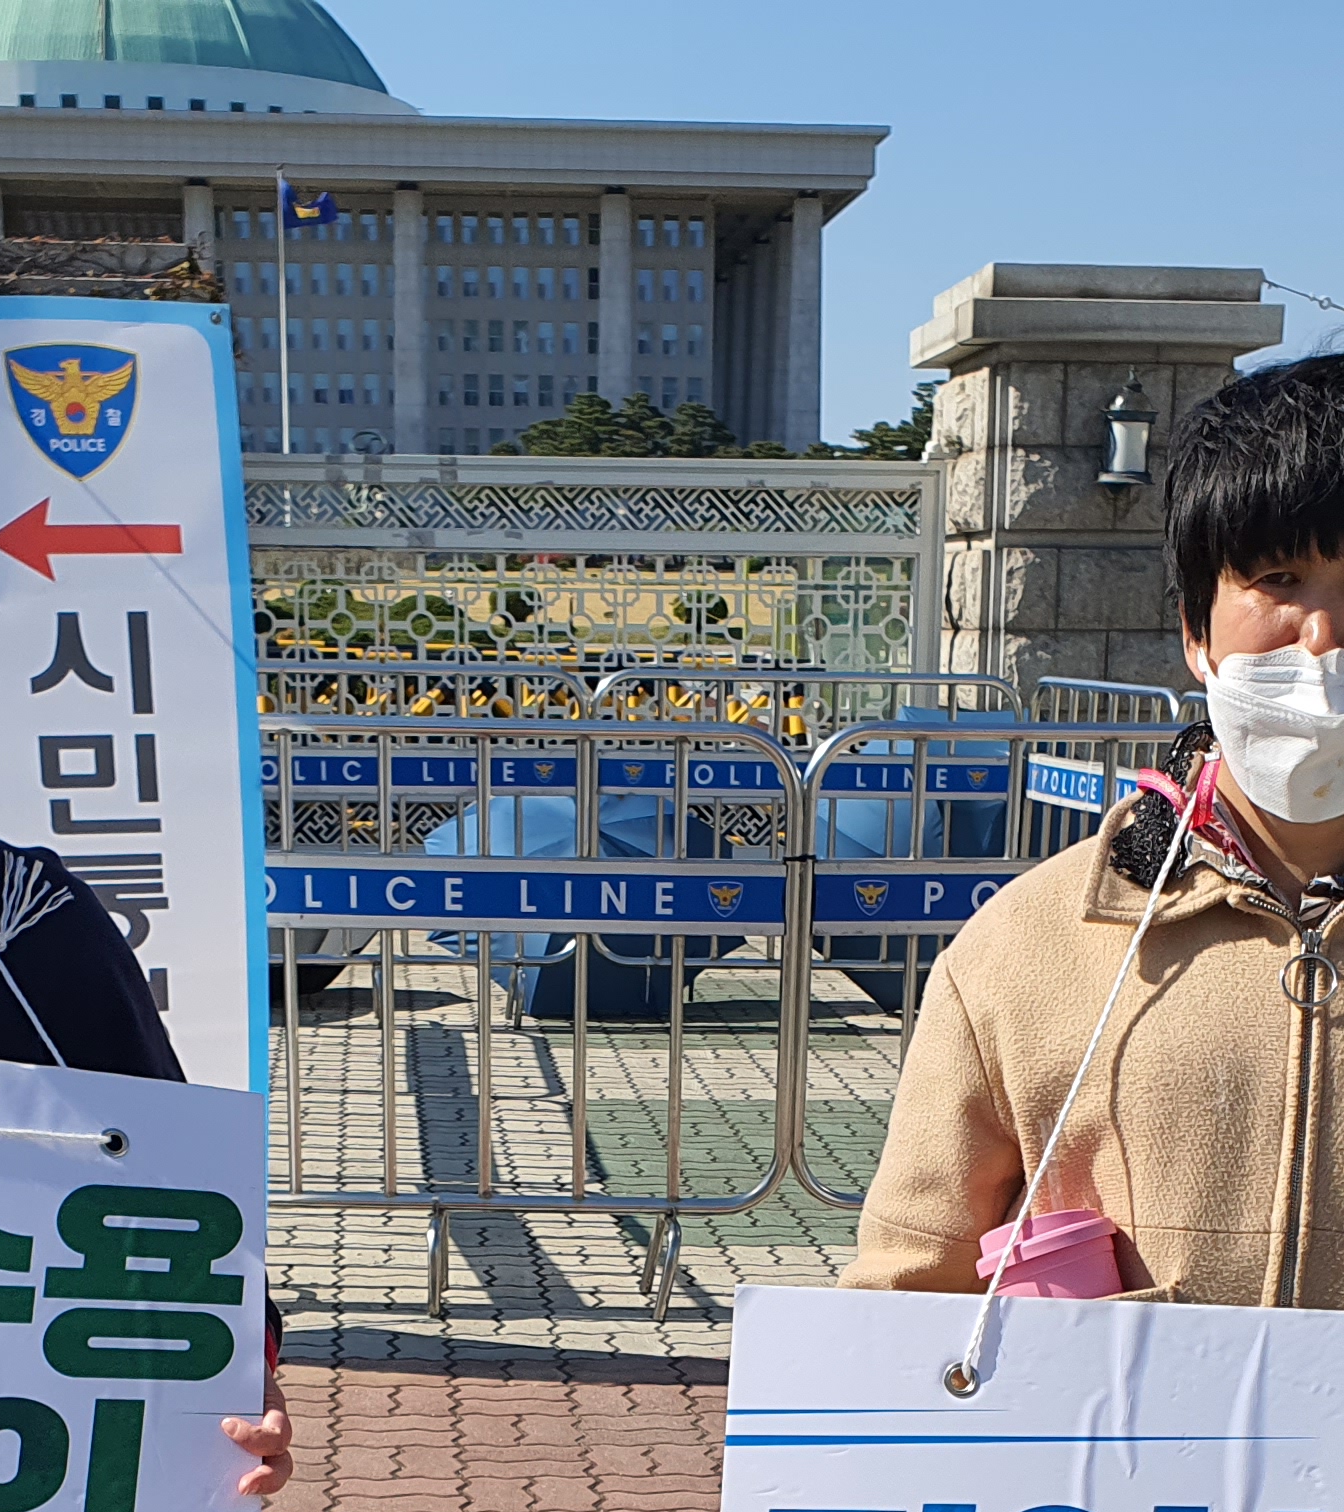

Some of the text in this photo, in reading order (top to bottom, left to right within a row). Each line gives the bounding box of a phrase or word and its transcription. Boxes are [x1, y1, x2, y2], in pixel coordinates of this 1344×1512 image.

[49, 438, 106, 452] POLICE
[261, 760, 363, 782] OLIC
[1041, 768, 1098, 800] POLICE
[520, 879, 674, 915] LINE
